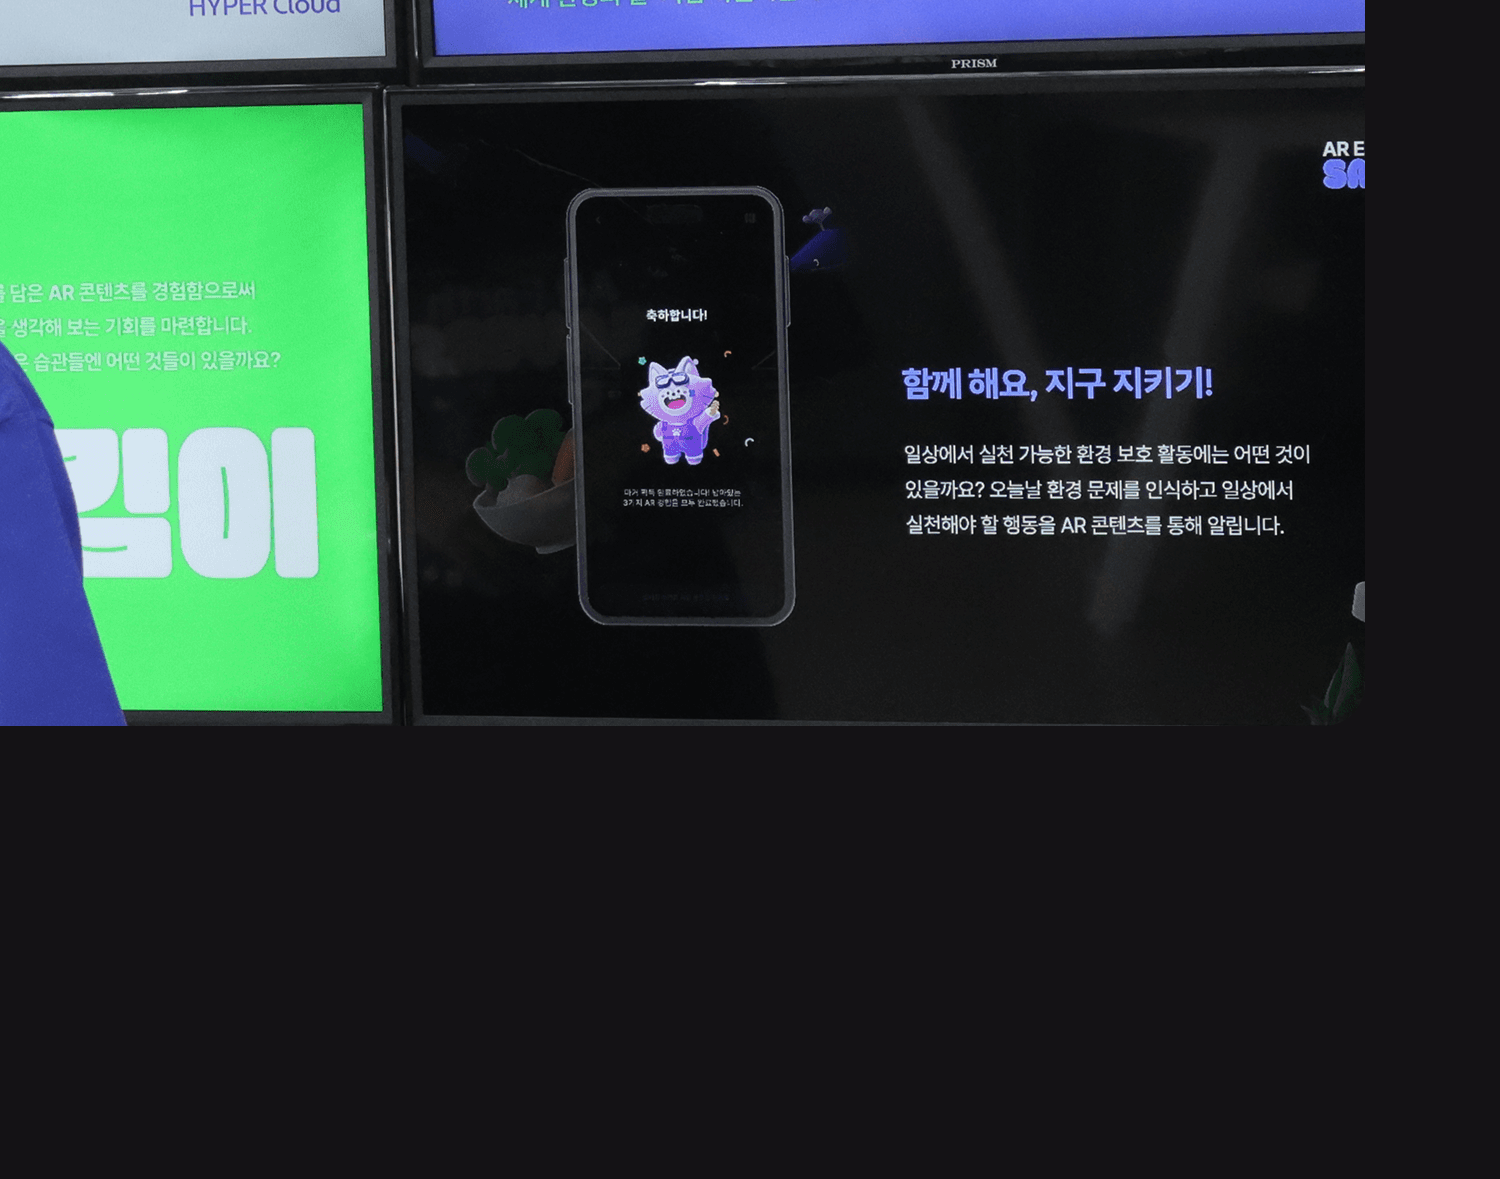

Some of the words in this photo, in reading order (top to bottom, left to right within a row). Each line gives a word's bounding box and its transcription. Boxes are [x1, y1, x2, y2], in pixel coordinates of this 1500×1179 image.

[951, 58, 998, 69] PRISM
[1322, 141, 1350, 157] AR
[9, 282, 45, 304] 담은
[48, 284, 75, 301] AR
[78, 281, 149, 303] 콘텐츠를
[151, 280, 256, 302] 경험함으로써
[646, 308, 708, 322] 축하합니다!
[11, 317, 62, 338] 생각해
[66, 318, 101, 337] 보는
[105, 316, 157, 337] 기회를
[160, 315, 253, 337] 마련합니다.
[33, 351, 102, 373] 습관들엔
[104, 350, 141, 372] 어떤
[145, 351, 196, 371] 것들이
[200, 349, 282, 371] 있을까요?
[901, 366, 962, 400] 함께
[967, 366, 1038, 403] 해요,
[1045, 366, 1107, 400] 지구
[1112, 366, 1213, 400] 지키기!
[904, 444, 974, 465] 일상에서
[979, 444, 1014, 465] 실천
[1019, 444, 1073, 465] 가능한
[1076, 444, 1112, 465] 환경
[1116, 444, 1154, 463] 보호
[1157, 443, 1230, 465] 활동에는
[1233, 444, 1271, 465] 어떤
[1275, 444, 1310, 465] 것이
[905, 479, 986, 500] 있을까요?
[989, 479, 1043, 500] 오늘날
[1046, 479, 1082, 500] 환경
[1086, 479, 1141, 501] 문제를
[1145, 479, 1218, 501] 인식하고
[1221, 479, 1293, 501] 일상에서
[905, 514, 977, 535] 실천해야
[980, 514, 999, 535] 할
[1002, 514, 1057, 536] 행동을
[1060, 516, 1087, 534] AR
[1091, 515, 1163, 536] 콘텐츠를
[1166, 515, 1203, 536] 통해
[1207, 515, 1285, 536] 알립니다.
